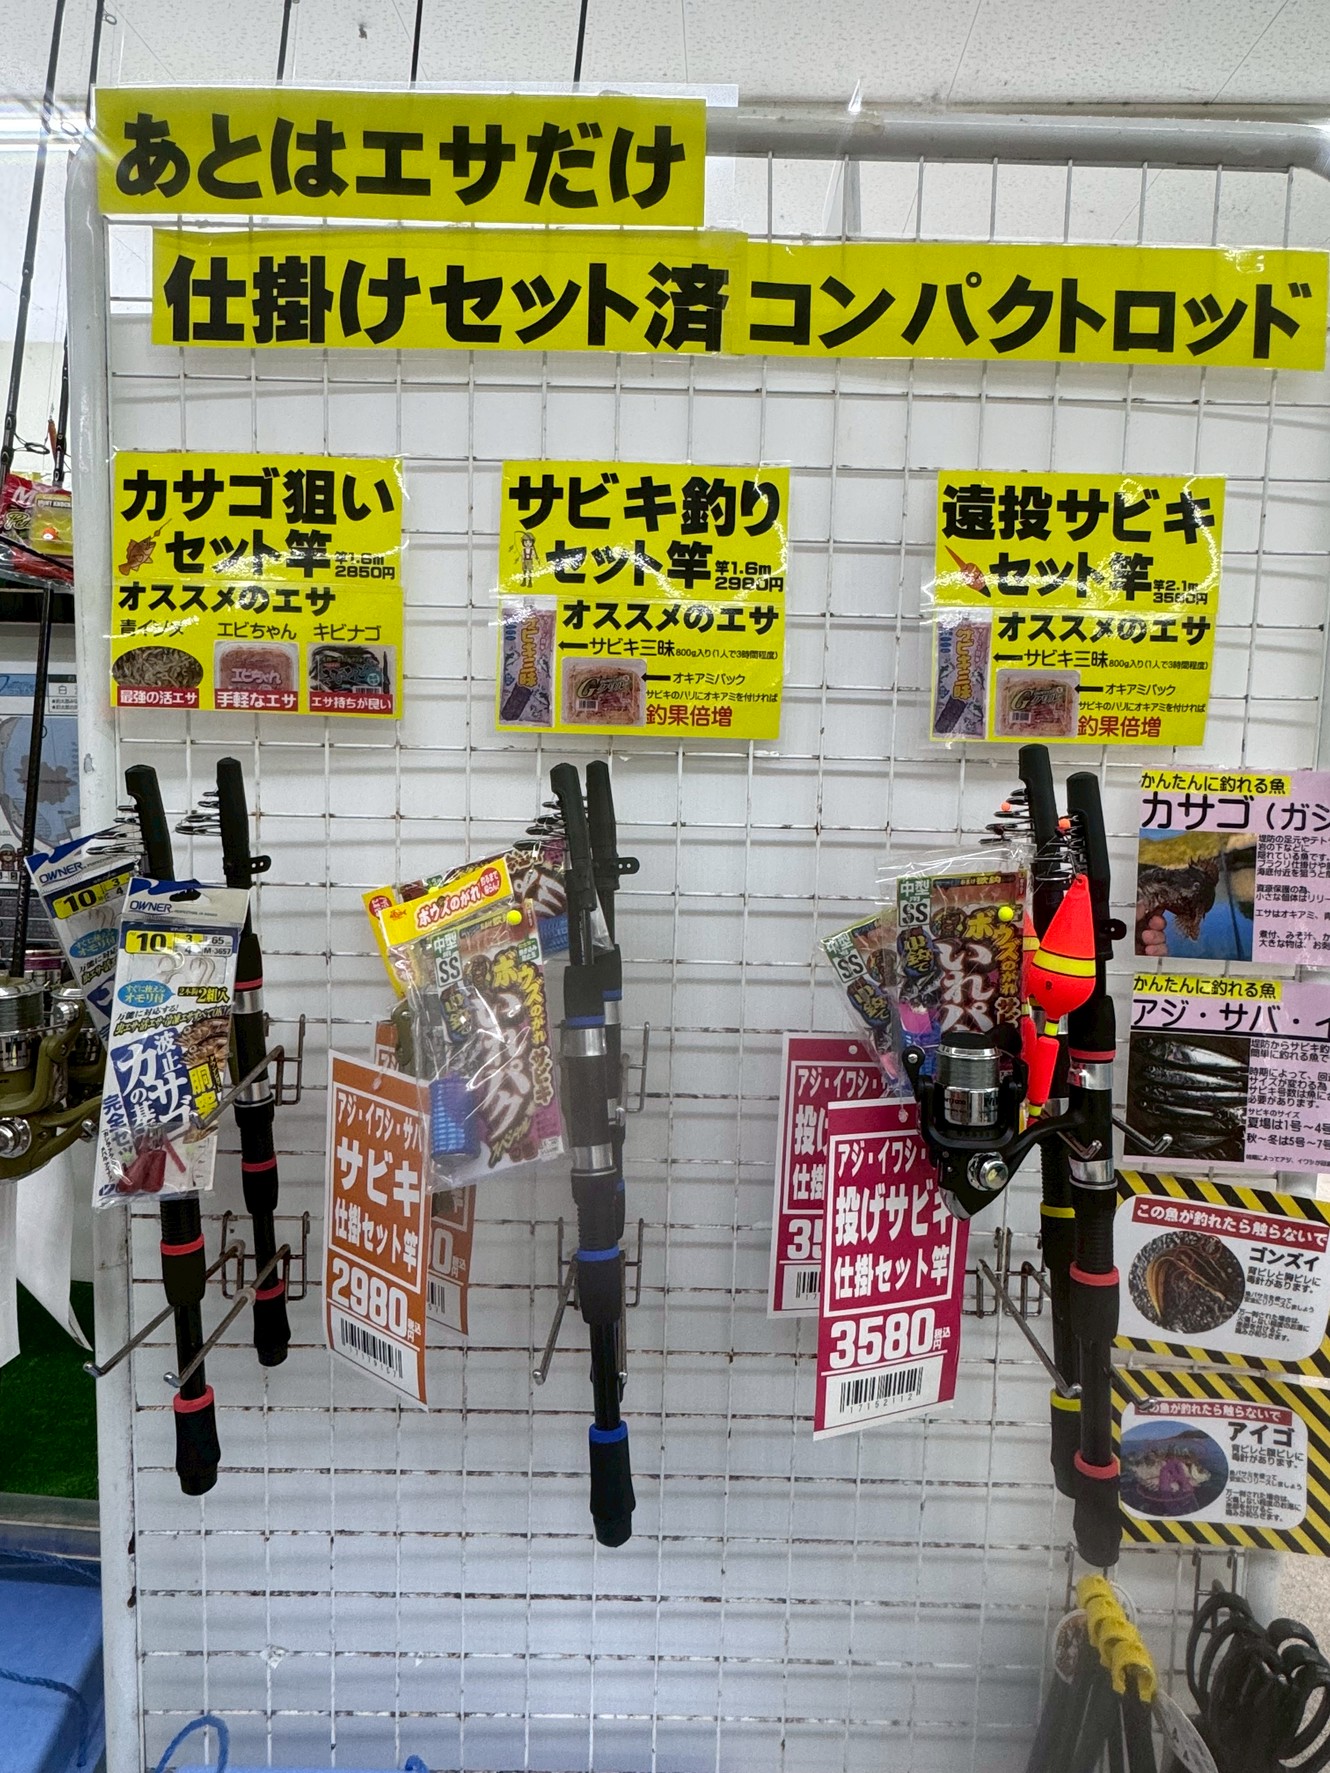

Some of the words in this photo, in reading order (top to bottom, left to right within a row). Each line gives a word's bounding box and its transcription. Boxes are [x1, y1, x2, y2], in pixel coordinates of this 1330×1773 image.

[115, 111, 687, 210] あとはエサだけ
[163, 253, 730, 352] 仕掛けセット済
[749, 271, 1313, 360] コンパクトロッド
[120, 466, 395, 526] カサゴ狙い
[509, 472, 780, 537] サビキ釣り
[941, 483, 1216, 545] 遠投サビキ
[165, 528, 333, 579] セット竿
[545, 539, 713, 590] セット竿
[334, 565, 396, 581] 2850円
[714, 560, 772, 577] 竿1.6m
[988, 551, 1154, 601] セット竿
[118, 581, 336, 617] オススメのエサ
[562, 599, 780, 635] オススメのエサ
[997, 611, 1211, 646] オススメのエサ
[217, 622, 297, 641] エビちゃん
[313, 623, 382, 642] キビナゴ
[672, 672, 746, 686] オキアミパック
[1104, 684, 1176, 697] オキアミパック
[120, 690, 198, 706] 最強の活エサ
[217, 691, 297, 709] 手軽なエサ
[311, 696, 392, 711] エサ持ちが良い
[646, 704, 733, 727] 釣果倍増
[1078, 715, 1161, 738] 釣果倍増
[1140, 772, 1286, 795] かんたんに釣れる魚
[38, 861, 84, 884] OWNER
[63, 889, 97, 913] 10
[900, 879, 930, 897] 中型
[129, 900, 173, 914] OWNER
[902, 902, 928, 924] SS
[136, 932, 167, 952] 10
[439, 956, 460, 984] SS
[837, 954, 864, 979] SS
[1133, 975, 1277, 999] かんたんに釣れる魚
[798, 1066, 887, 1098] アジ・イワシ・
[337, 1136, 420, 1217] サビキ
[835, 1179, 953, 1247] 投げサビキ
[1136, 1203, 1328, 1247] この魚が釣れたら触らないで
[335, 1197, 418, 1272] 仕掛セット竿
[833, 1244, 950, 1300] 仕掛セット竿
[1249, 1246, 1320, 1273] ゴンズイ
[331, 1257, 408, 1338] 2980
[829, 1307, 936, 1370] 3580
[1138, 1401, 1281, 1422] の魚が釣れたら触らないで
[1227, 1421, 1296, 1448] アイゴ
